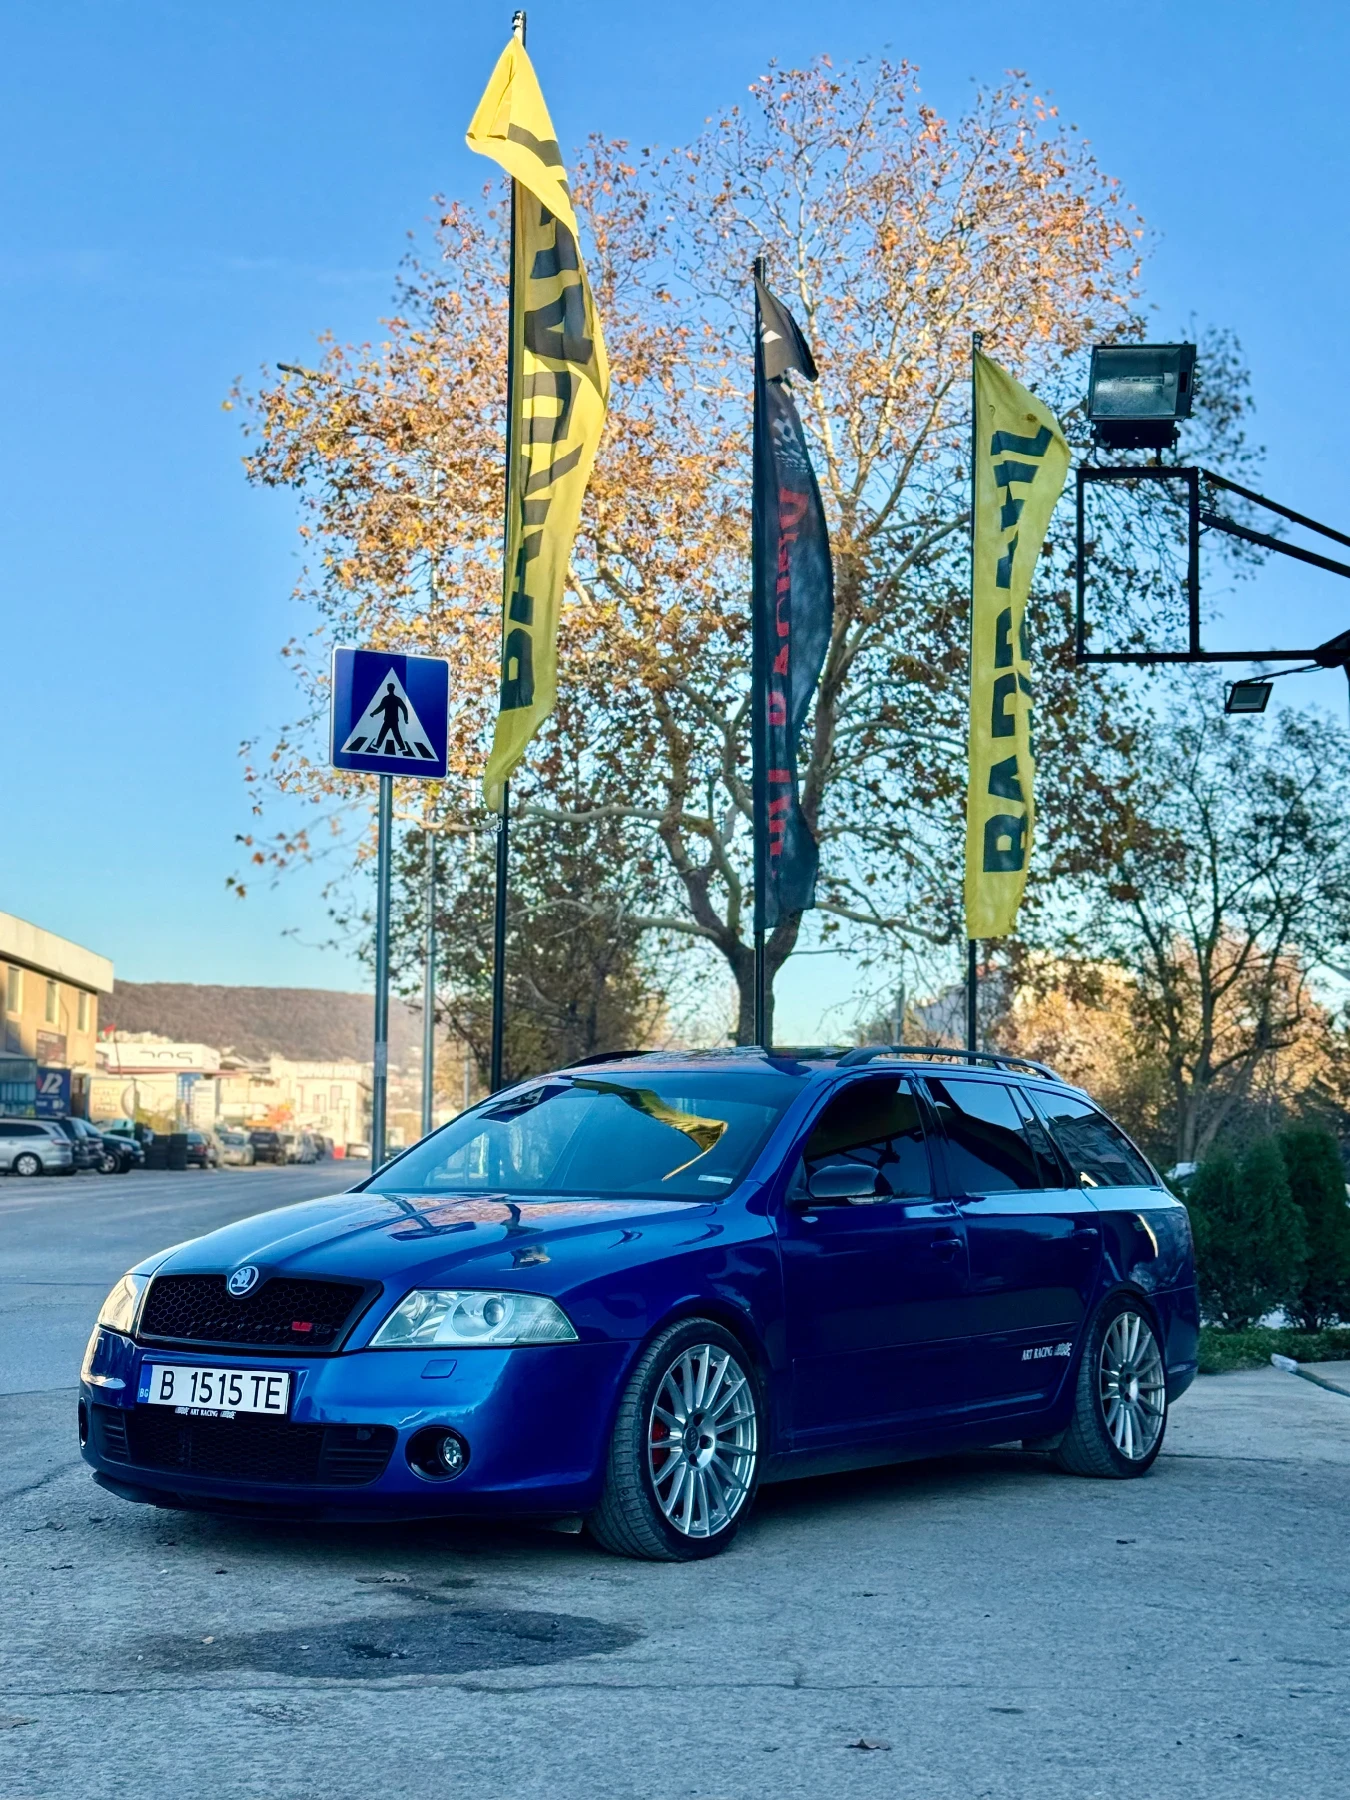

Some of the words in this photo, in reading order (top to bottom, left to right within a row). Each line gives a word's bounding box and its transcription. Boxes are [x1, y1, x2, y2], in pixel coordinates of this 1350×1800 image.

[1021, 1349, 1033, 1361] ART
[1034, 1346, 1053, 1359] RACING
[139, 1388, 149, 1398] BG
[160, 1371, 174, 1400] B
[191, 1372, 242, 1405] 1515
[251, 1376, 282, 1409] TE
[190, 1407, 199, 1415] ART
[200, 1409, 218, 1417] RACING
